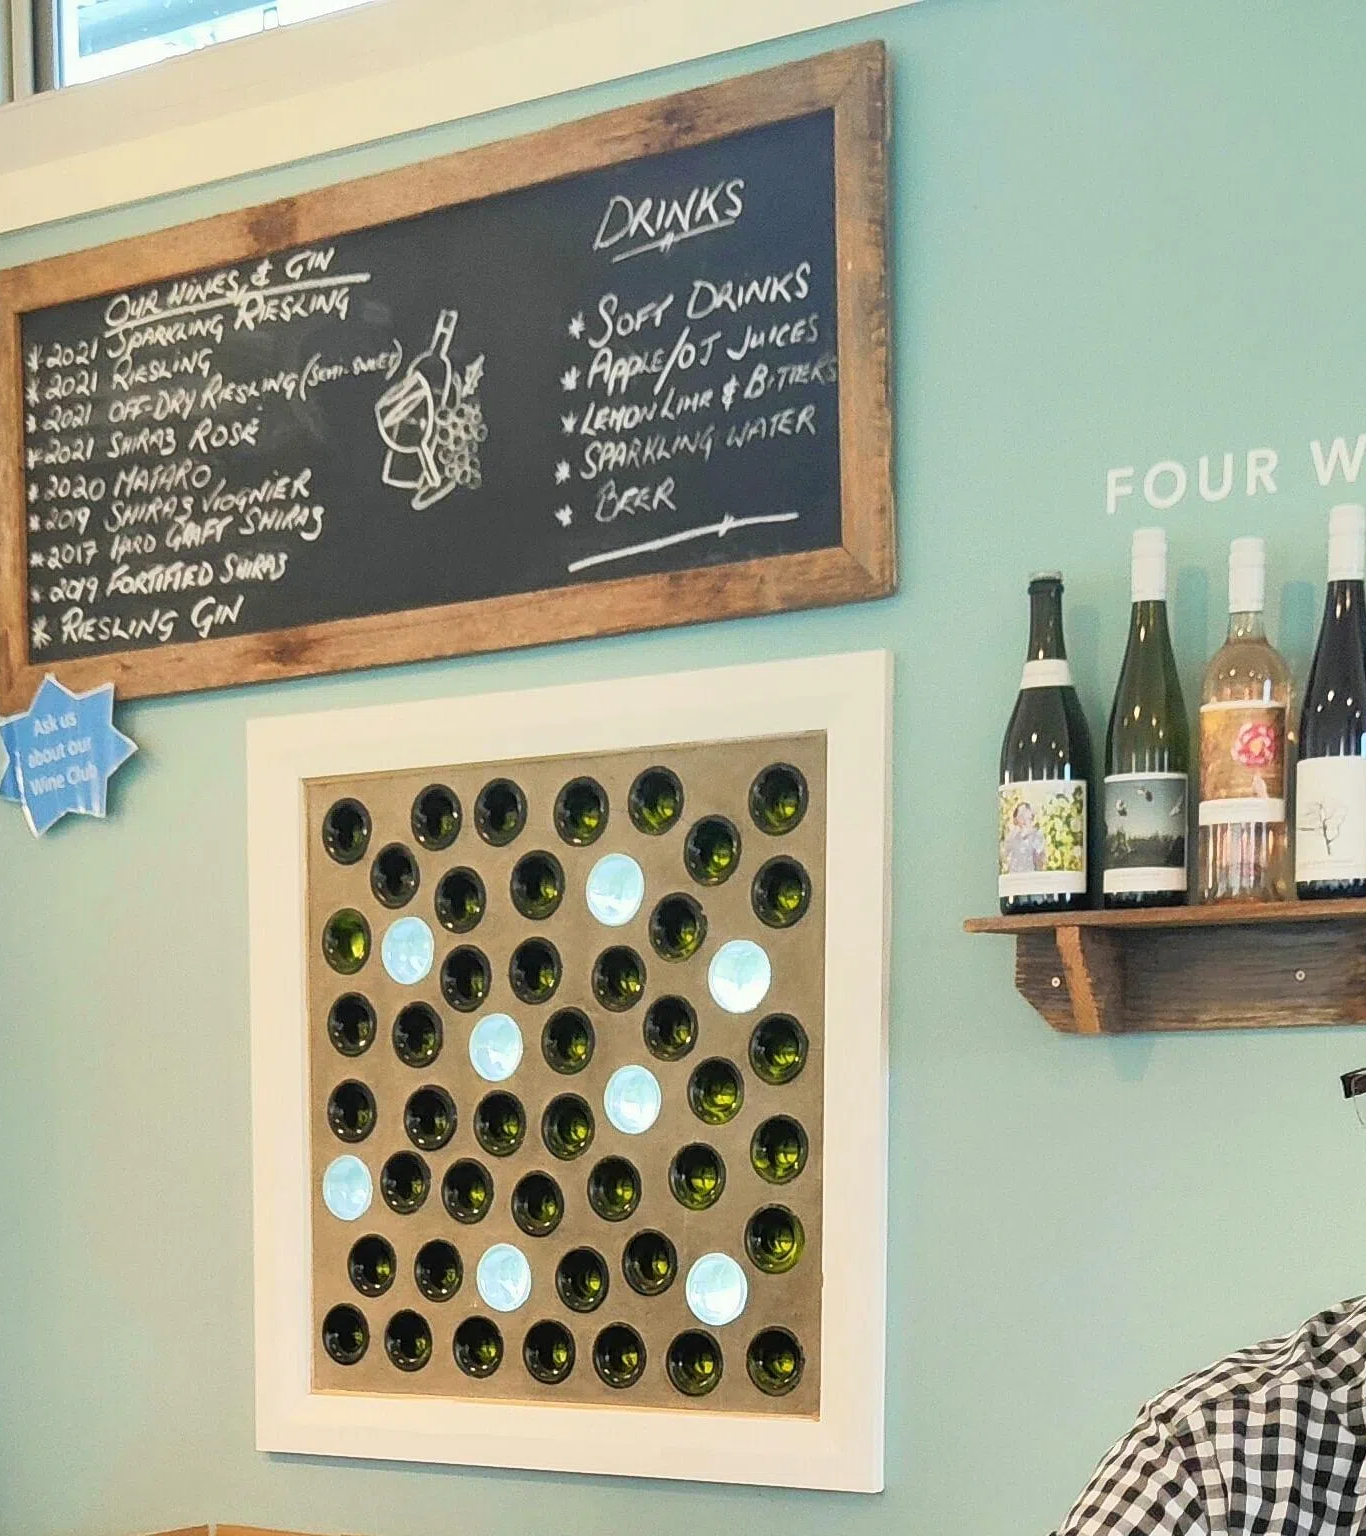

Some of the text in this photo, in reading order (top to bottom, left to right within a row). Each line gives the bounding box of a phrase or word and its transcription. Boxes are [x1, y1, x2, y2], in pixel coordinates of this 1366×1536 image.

[593, 178, 745, 251] DRINKS
[104, 291, 159, 328] OUR
[249, 259, 273, 287] &
[285, 247, 335, 282] GIN
[588, 261, 811, 349] SOFT DRINKS
[46, 287, 351, 370] 2021 SPARKLING RIESLING
[726, 313, 819, 361] JUICES
[46, 348, 214, 400] 2021 RIESLING
[42, 403, 92, 433] 2021
[200, 371, 298, 411] RIESLING
[579, 402, 657, 436] LEMON
[44, 437, 94, 465] 2021
[580, 403, 816, 481] SPARKLING WATER
[46, 506, 91, 535] 2019
[202, 467, 312, 513] VIOGNIER
[48, 457, 212, 502] 2020 MATARO
[595, 477, 676, 523] BEER
[1106, 448, 1278, 515] FOUR
[48, 538, 99, 571] 2017
[49, 576, 99, 603] 2019
[106, 560, 215, 597] FORTIFIED
[61, 594, 245, 644] RIESLING GIN
[34, 711, 77, 737] Ask us
[28, 737, 91, 768] about our
[29, 761, 98, 796] Wine Club
